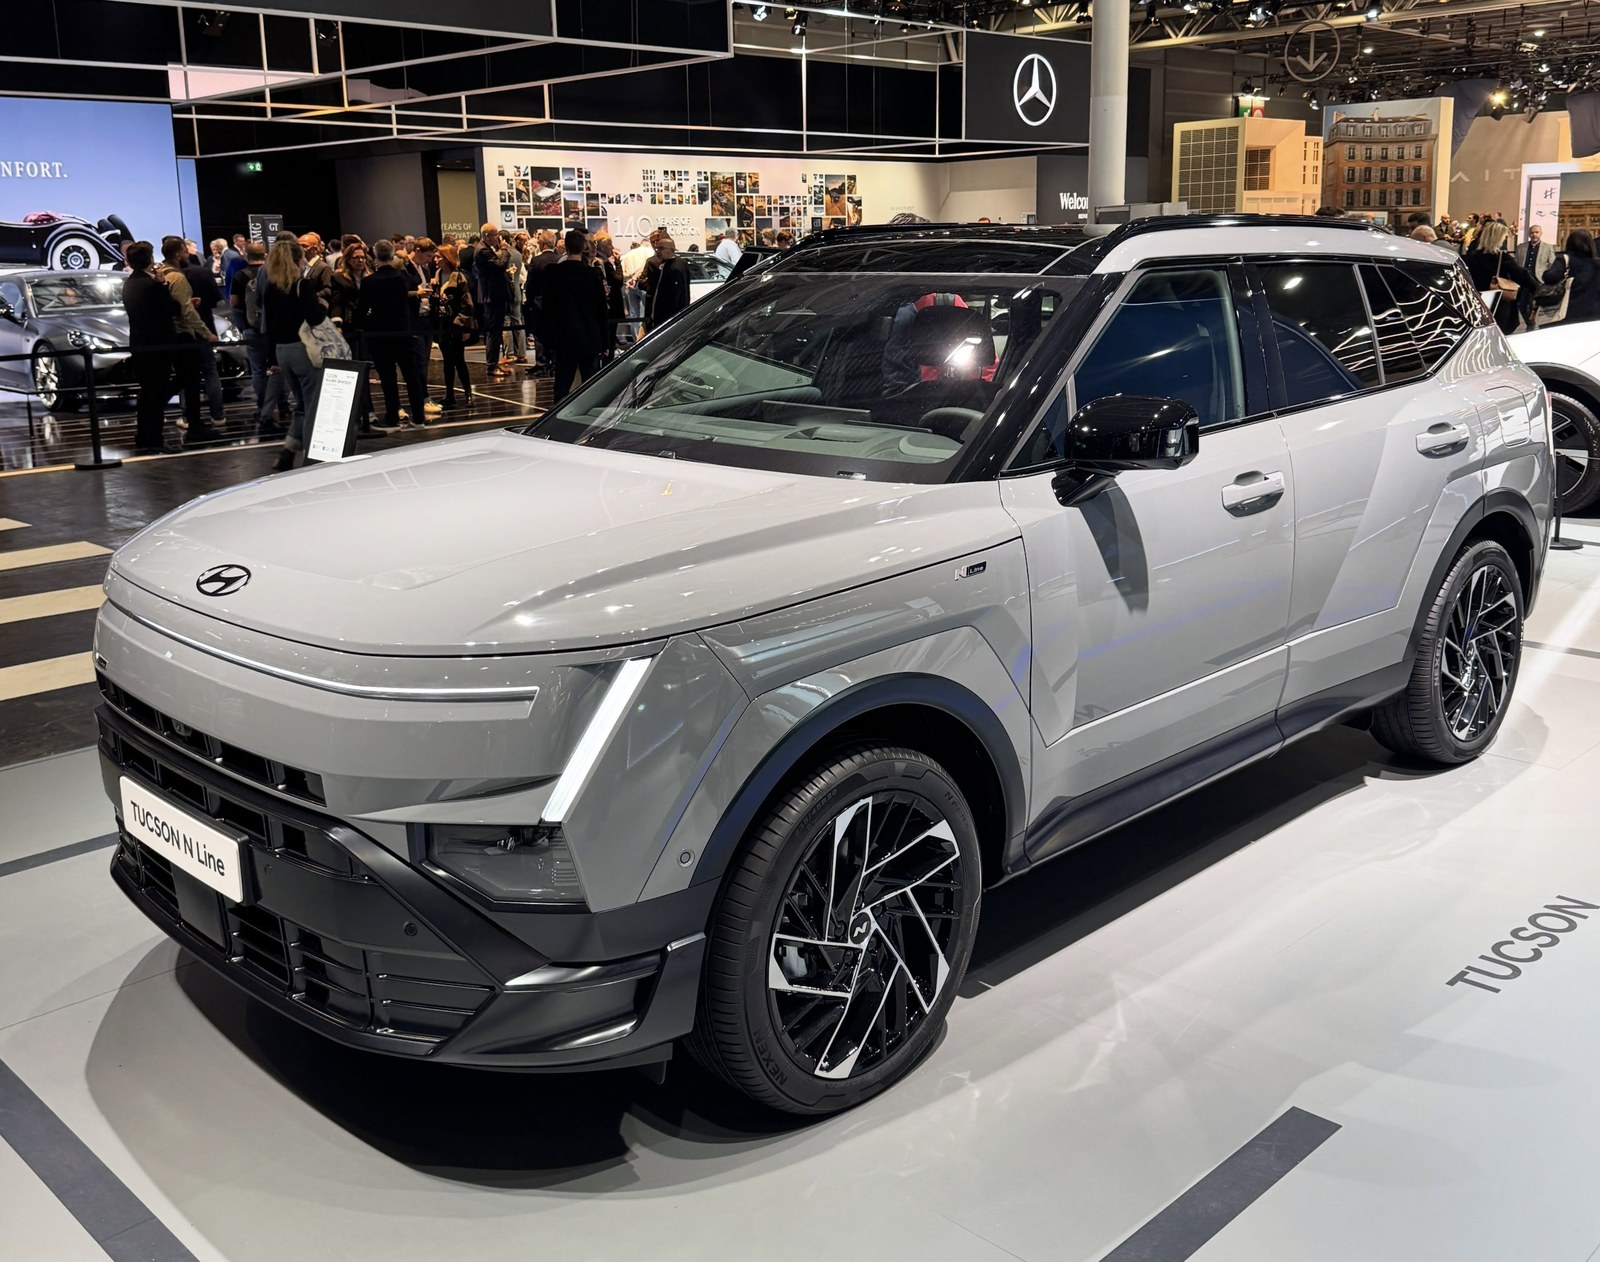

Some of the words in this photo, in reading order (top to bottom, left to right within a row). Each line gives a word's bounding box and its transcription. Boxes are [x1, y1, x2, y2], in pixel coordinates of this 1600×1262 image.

[0, 161, 68, 178] NFORT.
[613, 216, 653, 238] 140
[130, 800, 181, 851] TUCSON
[183, 833, 194, 859] N
[196, 841, 226, 877] Line
[1445, 894, 1600, 994] TUCSON
[753, 1030, 788, 1085] NEXEN
